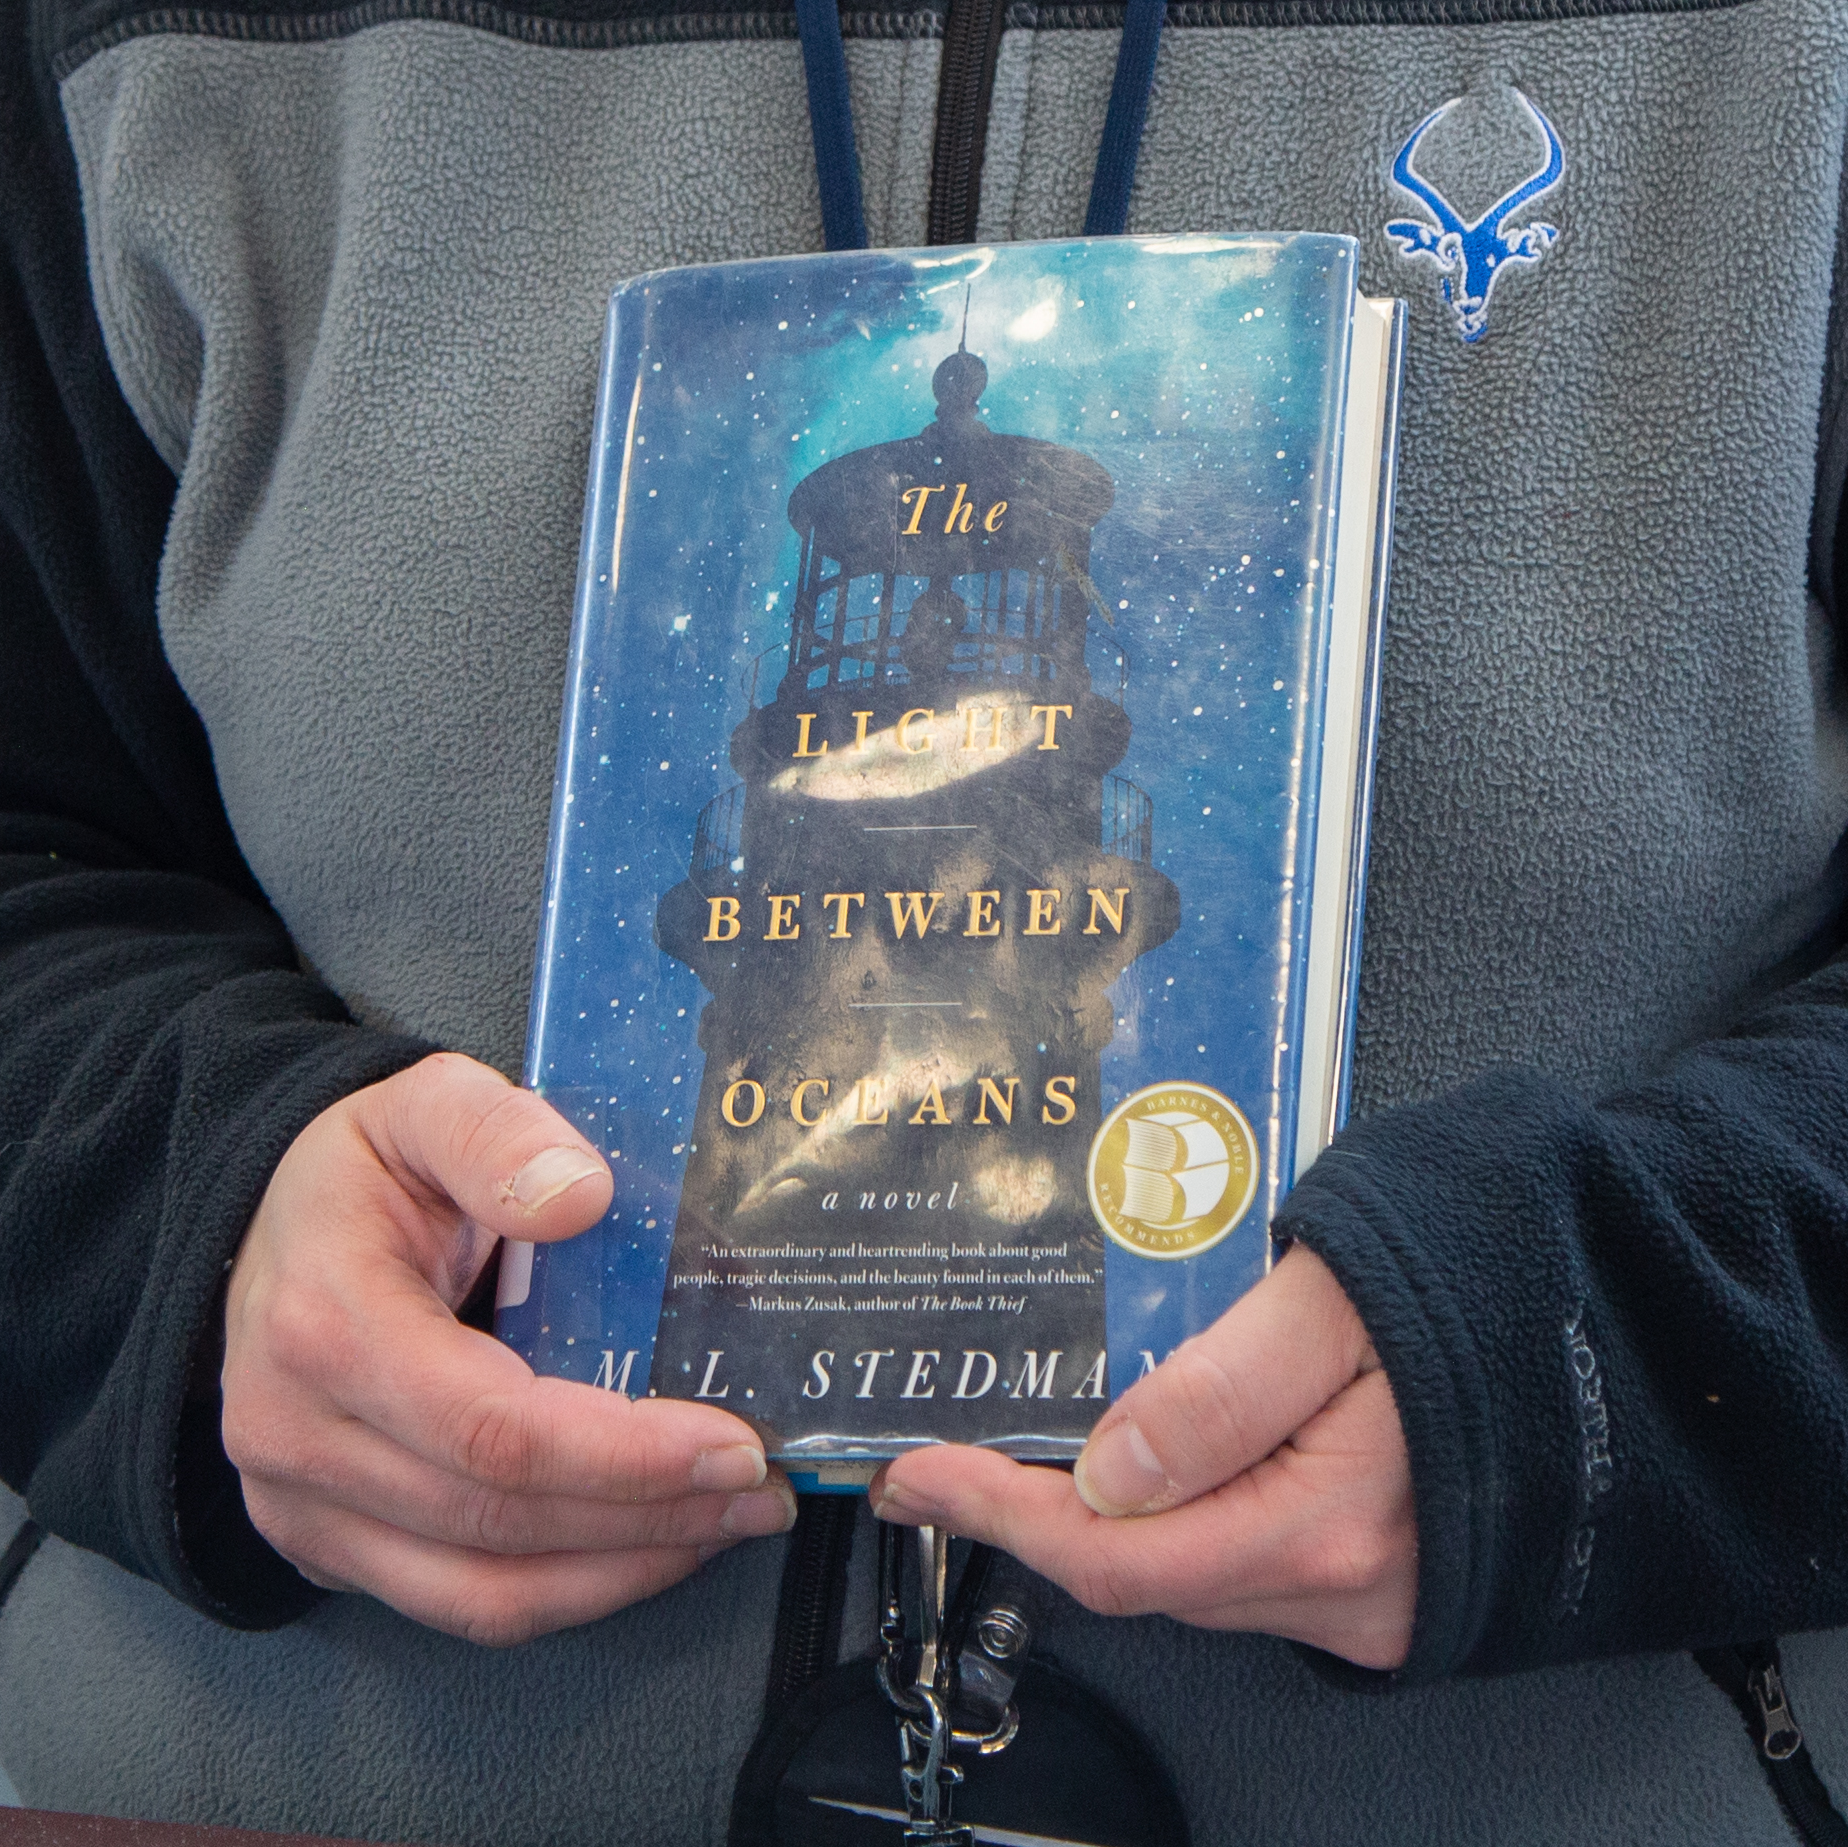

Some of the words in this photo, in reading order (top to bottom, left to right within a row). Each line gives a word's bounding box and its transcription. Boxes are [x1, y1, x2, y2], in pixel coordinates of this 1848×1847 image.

[901, 484, 1009, 536] The
[792, 704, 1073, 758] LIGHT
[702, 888, 1130, 942] BETWEEN
[721, 1075, 1077, 1127] OCEANS
[1146, 1095, 1208, 1112] BARNES
[1212, 1109, 1221, 1122] &
[1222, 1121, 1245, 1175] NOBLE
[821, 1191, 839, 1210] a
[859, 1182, 959, 1210] novel
[1100, 1182, 1196, 1245] RECOMMENDS
[701, 1243, 728, 1258] “An
[730, 1242, 825, 1262] extraordinary
[829, 1242, 855, 1258] and
[858, 1241, 949, 1261] heartrending
[951, 1241, 986, 1258] book
[988, 1241, 1029, 1258] about
[1031, 1242, 1068, 1261] good
[673, 1269, 724, 1289] people,
[727, 1269, 767, 1288] tragic
[768, 1269, 837, 1287] decisions,
[840, 1269, 866, 1284] and
[869, 1269, 891, 1284] the
[893, 1268, 940, 1288] beauty
[943, 1268, 984, 1284] found
[987, 1268, 1001, 1284] in
[1003, 1268, 1036, 1284] each
[1038, 1268, 1054, 1284] of
[1054, 1268, 1103, 1284] them.”
[804, 1296, 851, 1314] Zusak,
[854, 1295, 903, 1311] author
[903, 1295, 919, 1311] of
[921, 1295, 947, 1311] The
[950, 1295, 984, 1311] Book
[987, 1295, 1029, 1315] Thief
[592, 1350, 656, 1398] M.
[694, 1350, 755, 1398] L.
